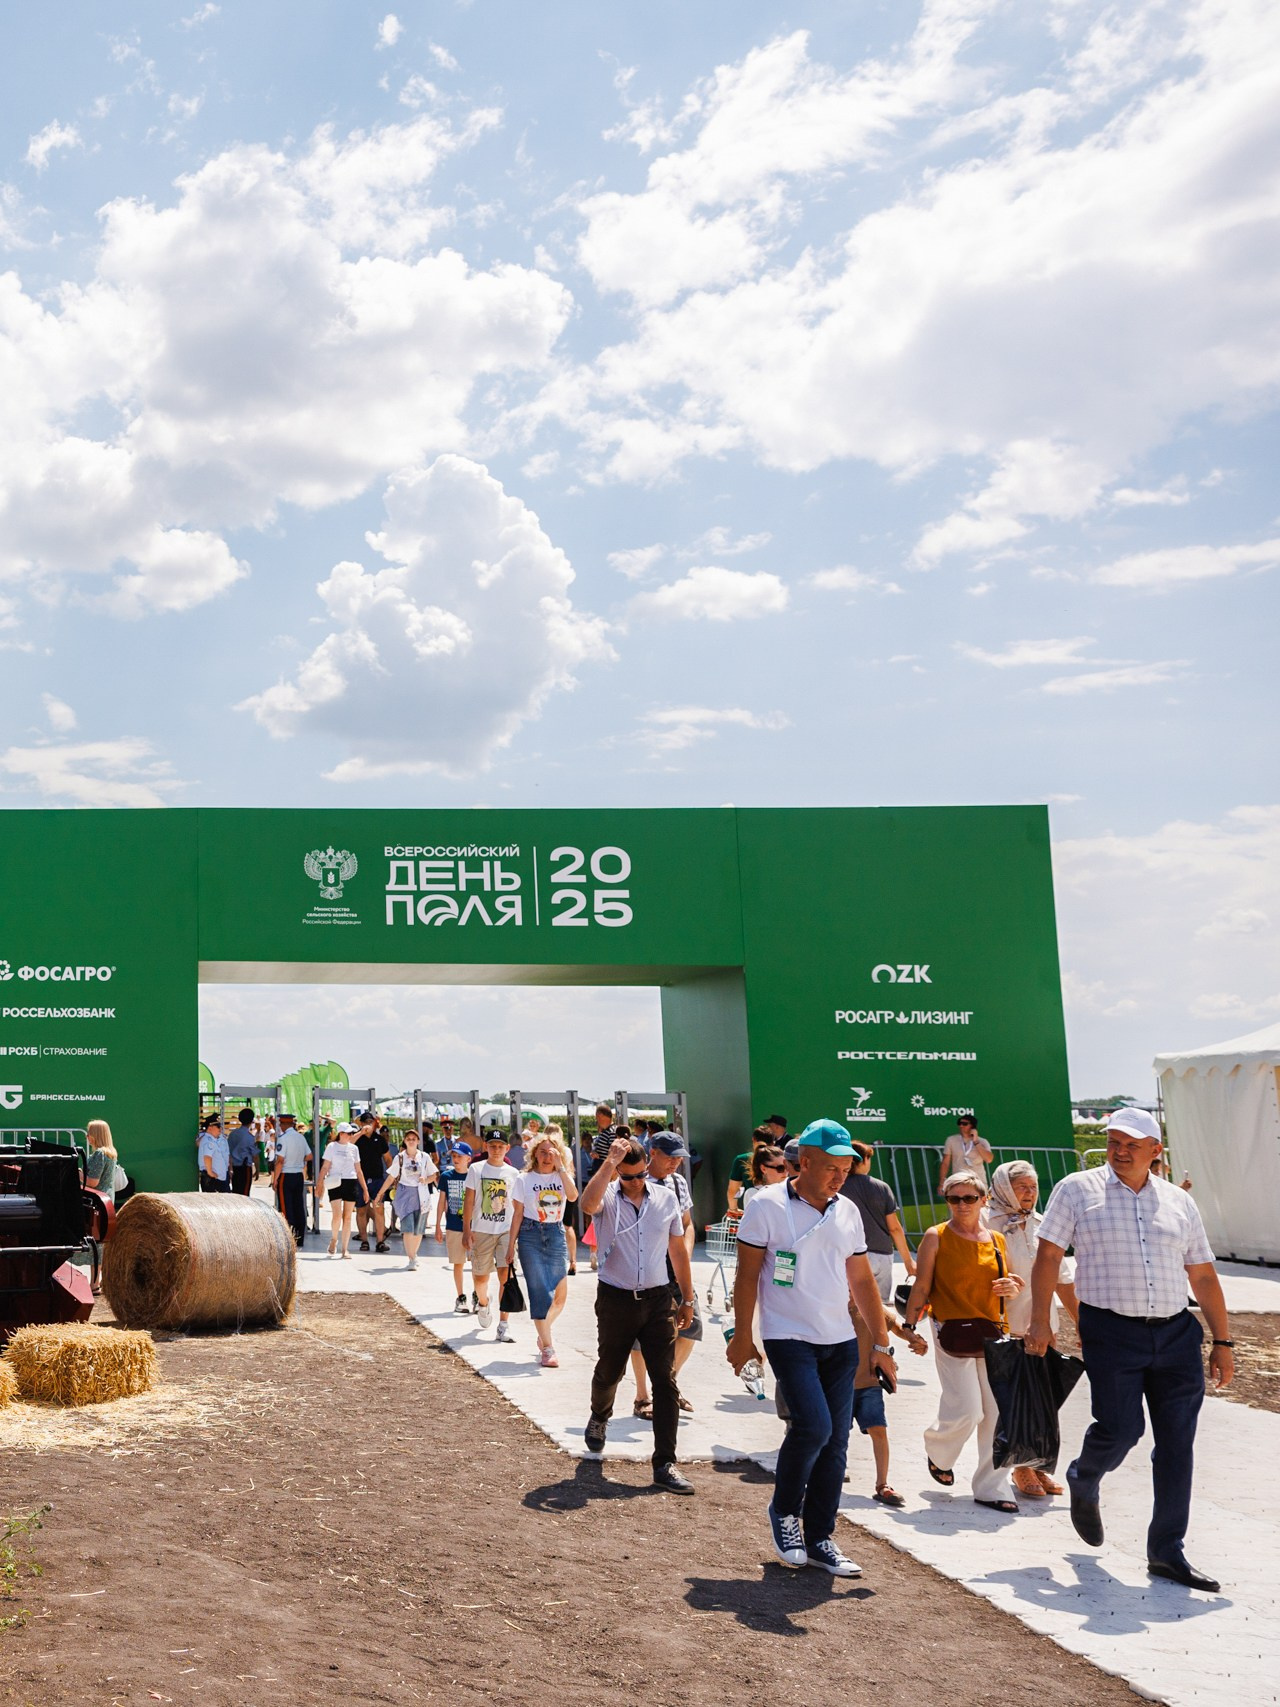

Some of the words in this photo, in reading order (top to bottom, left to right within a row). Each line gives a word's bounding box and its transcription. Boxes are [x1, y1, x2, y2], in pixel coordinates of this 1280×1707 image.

[384, 844, 520, 857] ВСЕРОССИЙСКИЙ
[550, 846, 632, 884] 20
[385, 860, 522, 892] ДЕНЬ
[385, 894, 523, 927] ПОЛЯ
[551, 889, 634, 928] 25
[2, 1007, 116, 1018] РОССЕЛЬХОЗБАНК
[8, 1046, 38, 1056] РСХБ
[42, 1047, 108, 1056] СТРАХОВАНИЕ
[837, 1051, 977, 1061] РОСТСЕЛЬМАШ
[846, 1108, 886, 1116] ПЕГАС
[532, 1183, 563, 1192] étoile
